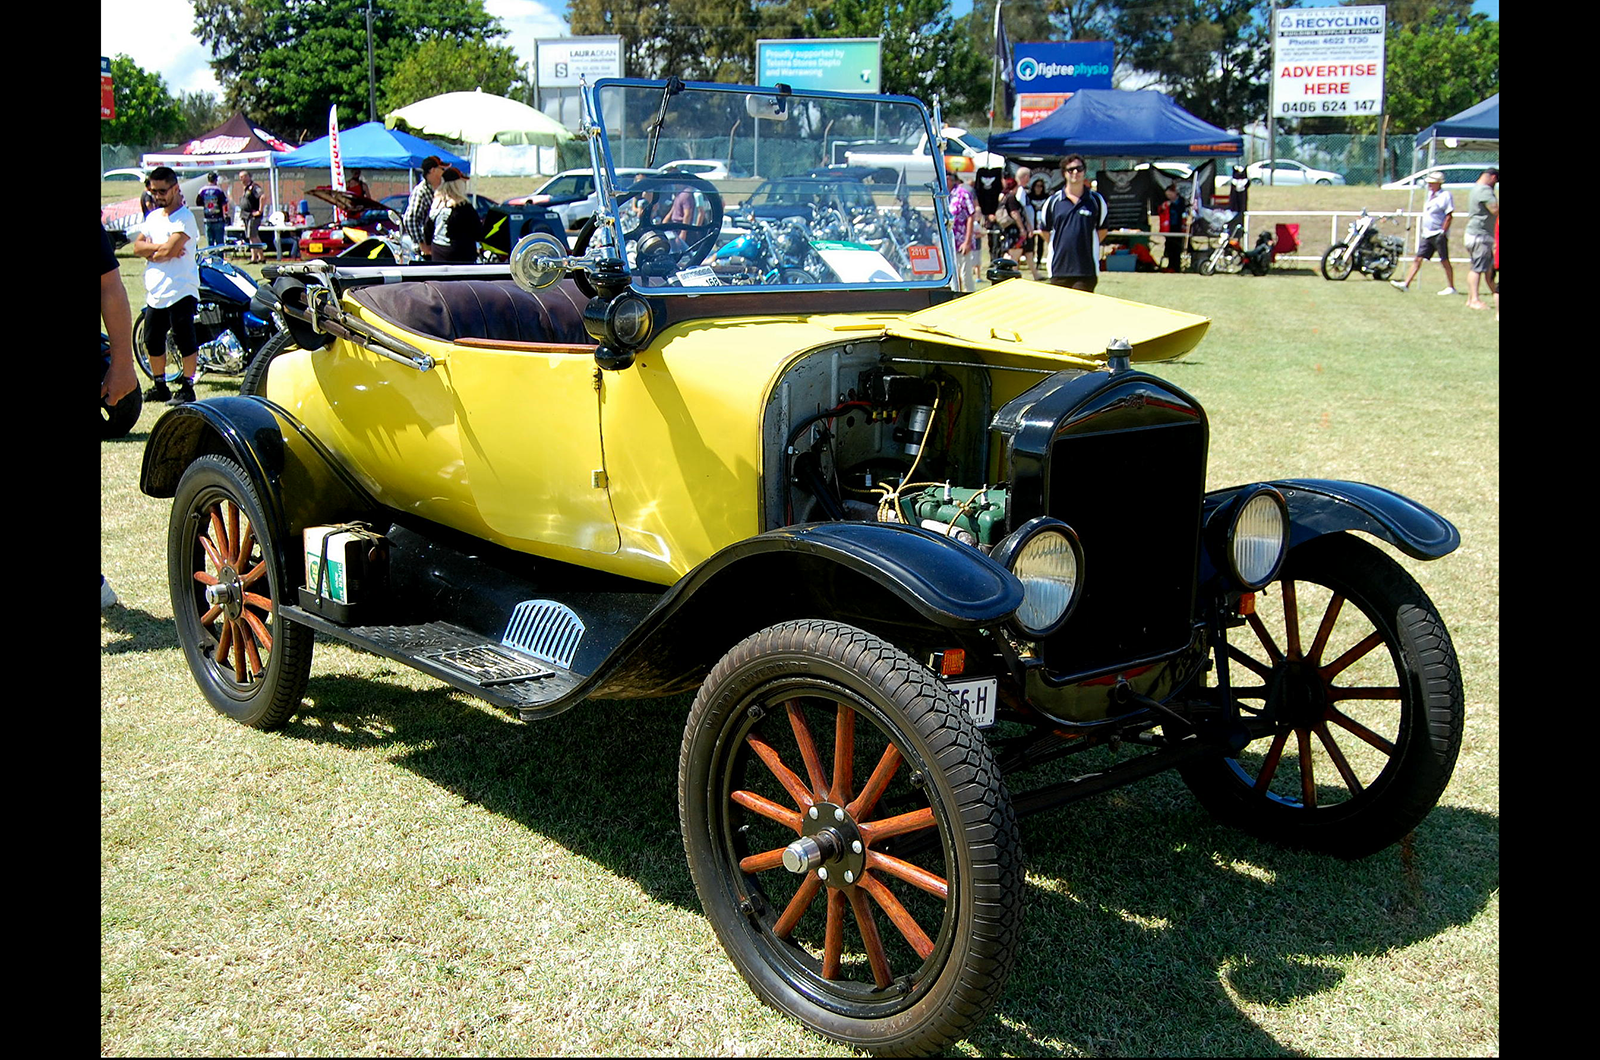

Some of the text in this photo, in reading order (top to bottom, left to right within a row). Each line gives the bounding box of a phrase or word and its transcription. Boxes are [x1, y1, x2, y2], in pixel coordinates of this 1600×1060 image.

[1296, 16, 1379, 28] RECYCLING
[766, 49, 844, 59] Proudly supported by
[766, 59, 841, 67] Telstra Stores Dapto
[766, 68, 823, 78] and Warrawong
[1281, 64, 1377, 78] ADVERTISE
[1304, 82, 1351, 95] HERE
[1282, 100, 1375, 112] 0406 624 147
